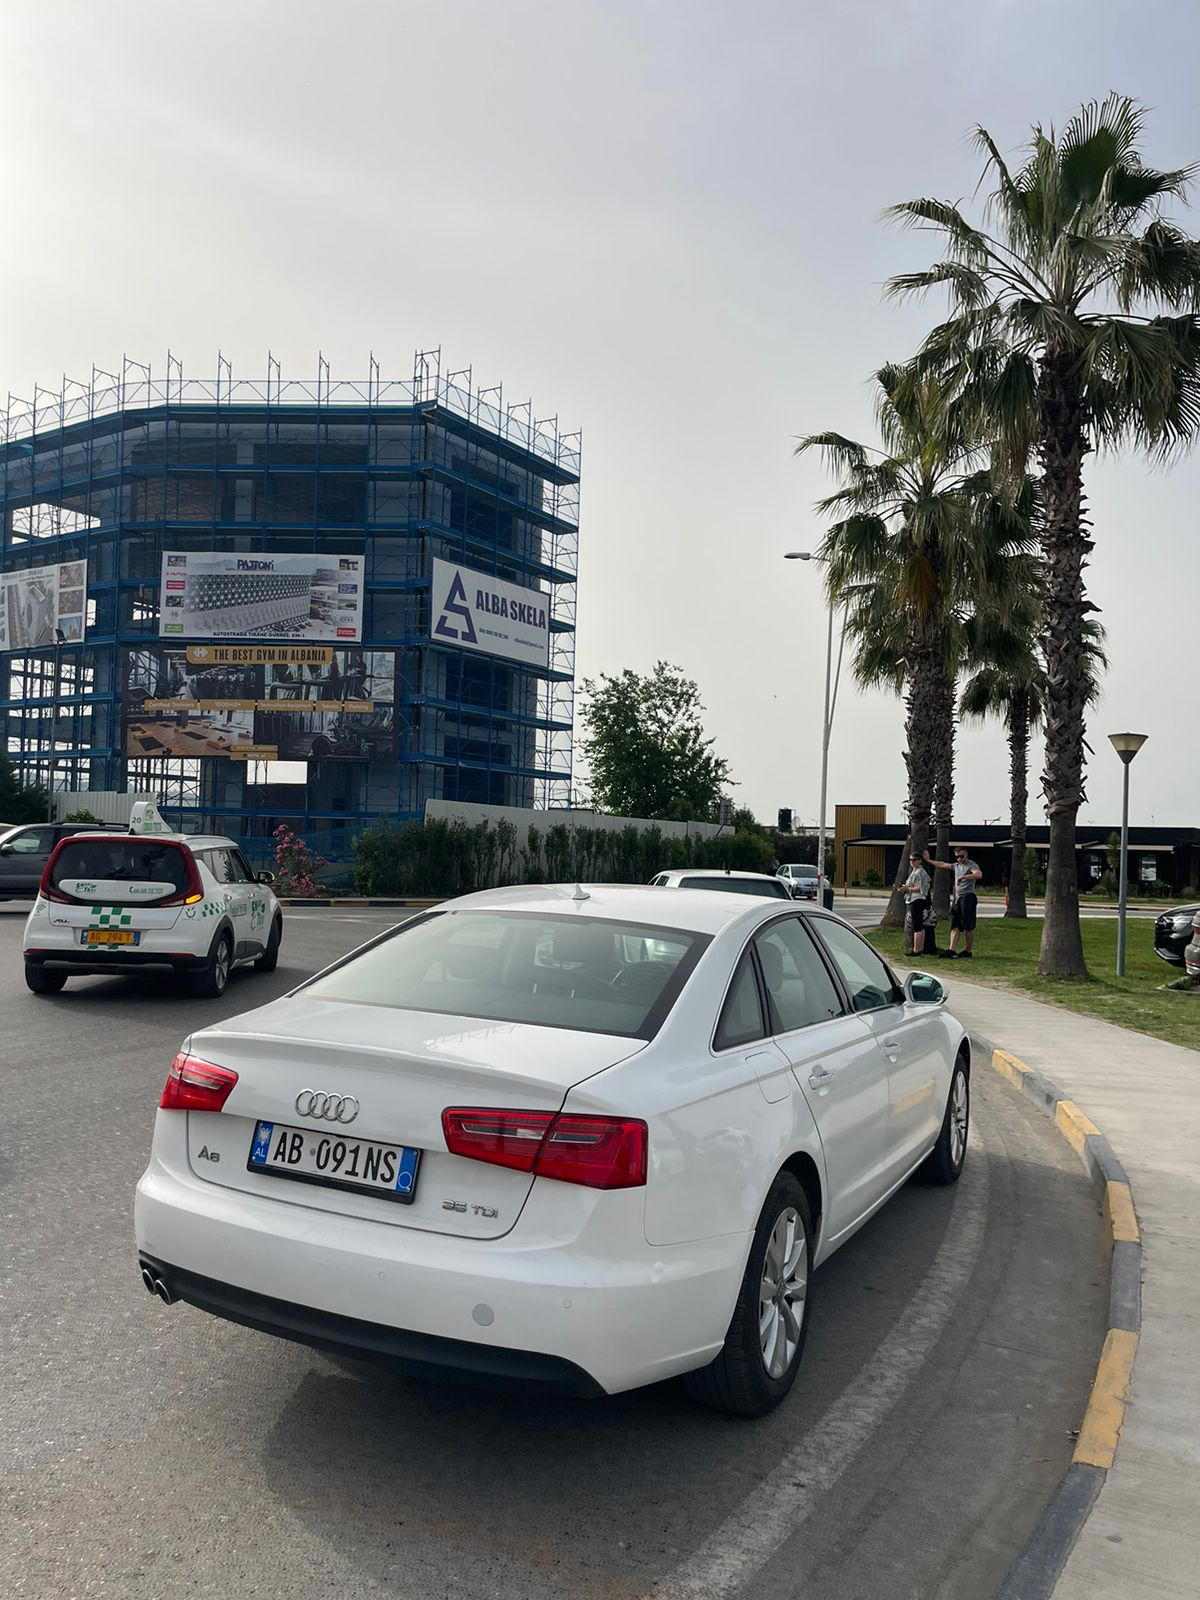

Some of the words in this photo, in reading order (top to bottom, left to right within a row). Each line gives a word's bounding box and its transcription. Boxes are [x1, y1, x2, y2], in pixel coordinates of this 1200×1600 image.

[475, 589, 508, 617] ALBA
[510, 600, 546, 629] SKELA
[214, 649, 228, 661] THE
[232, 649, 253, 661] BEST
[257, 649, 275, 661] GYM
[278, 649, 288, 661] IN
[290, 649, 326, 661] ALBANIA
[131, 816, 142, 824] 20
[90, 932, 101, 941] AG
[198, 1145, 220, 1163] A6
[254, 1147, 266, 1158] AL
[273, 1131, 304, 1164] AB
[315, 1138, 398, 1183] 091NS
[471, 1203, 500, 1219] TDI
